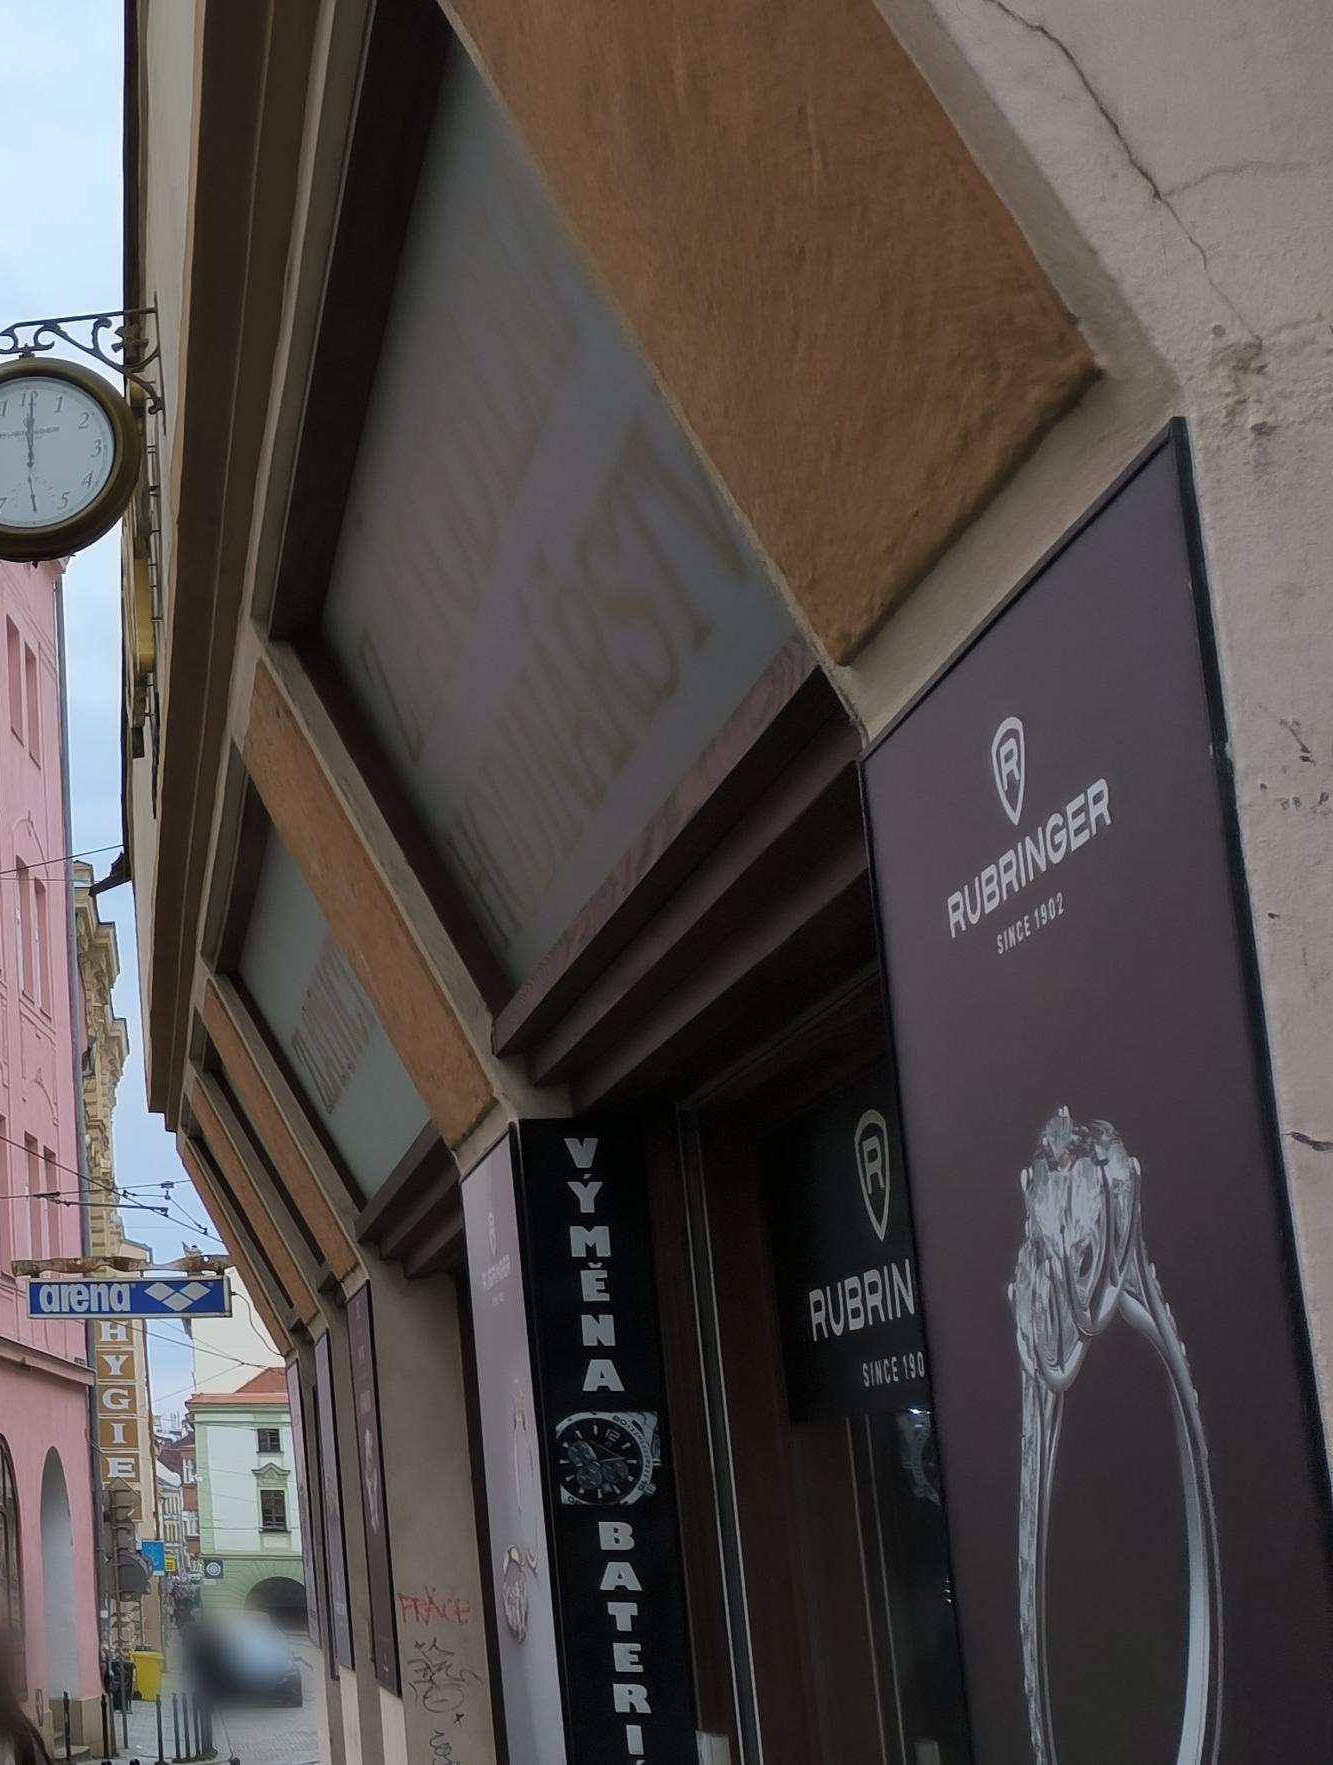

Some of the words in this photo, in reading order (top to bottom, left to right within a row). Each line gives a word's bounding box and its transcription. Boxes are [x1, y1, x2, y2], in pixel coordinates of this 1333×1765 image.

[54, 395, 63, 413] 1
[78, 412, 90, 430] 2
[90, 439, 102, 457] 3
[82, 471, 93, 488] 4
[57, 492, 70, 509] 5
[947, 778, 1111, 938] RUBRINGER
[997, 914, 1031, 954] SINCE
[1033, 892, 1065, 929] 1902
[564, 1137, 625, 1391] VÝMĚNA
[39, 1283, 131, 1312] arena
[862, 1356, 899, 1387] SINCE
[100, 1321, 135, 1516] HYGIE
[598, 1521, 653, 1765] BATERI
